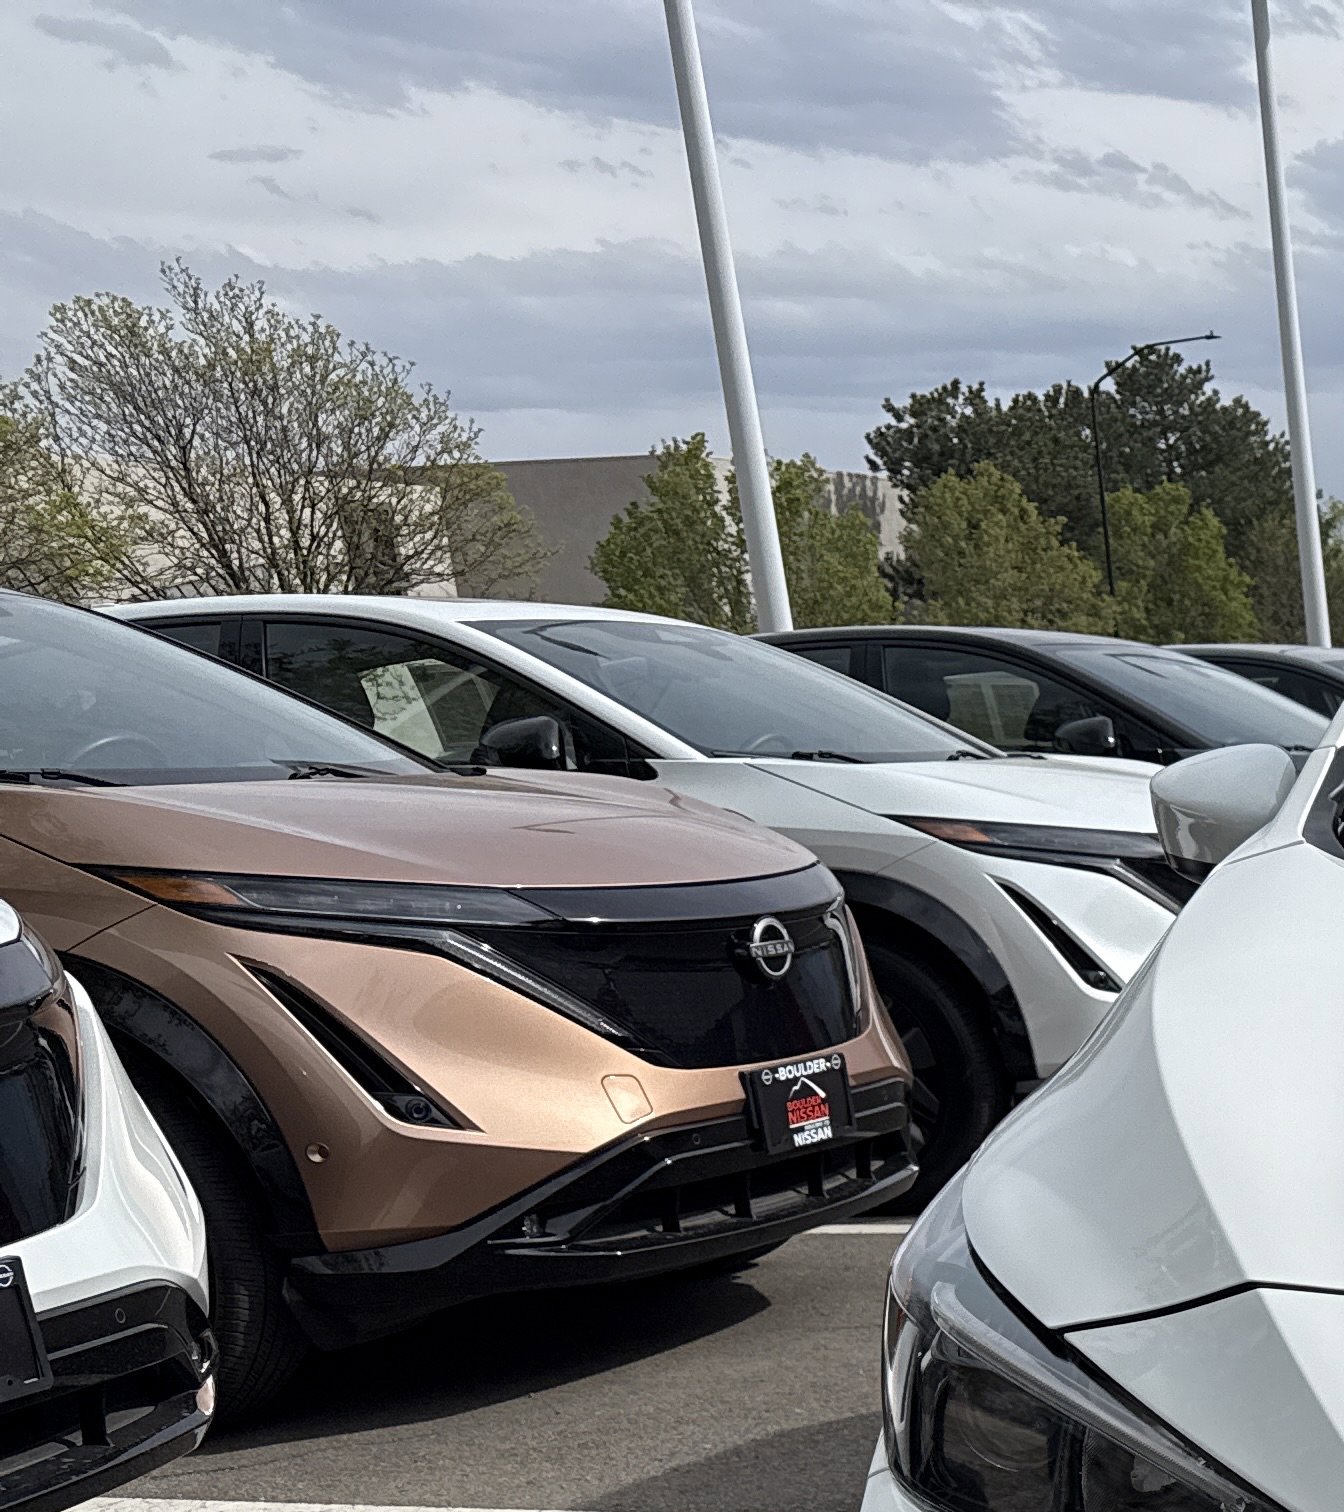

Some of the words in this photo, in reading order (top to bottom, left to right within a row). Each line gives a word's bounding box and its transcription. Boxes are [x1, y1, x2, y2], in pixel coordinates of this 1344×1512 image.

[778, 1058, 827, 1080] BOULDER
[788, 1103, 829, 1125] NISSAN
[793, 1126, 832, 1147] NISSAN
